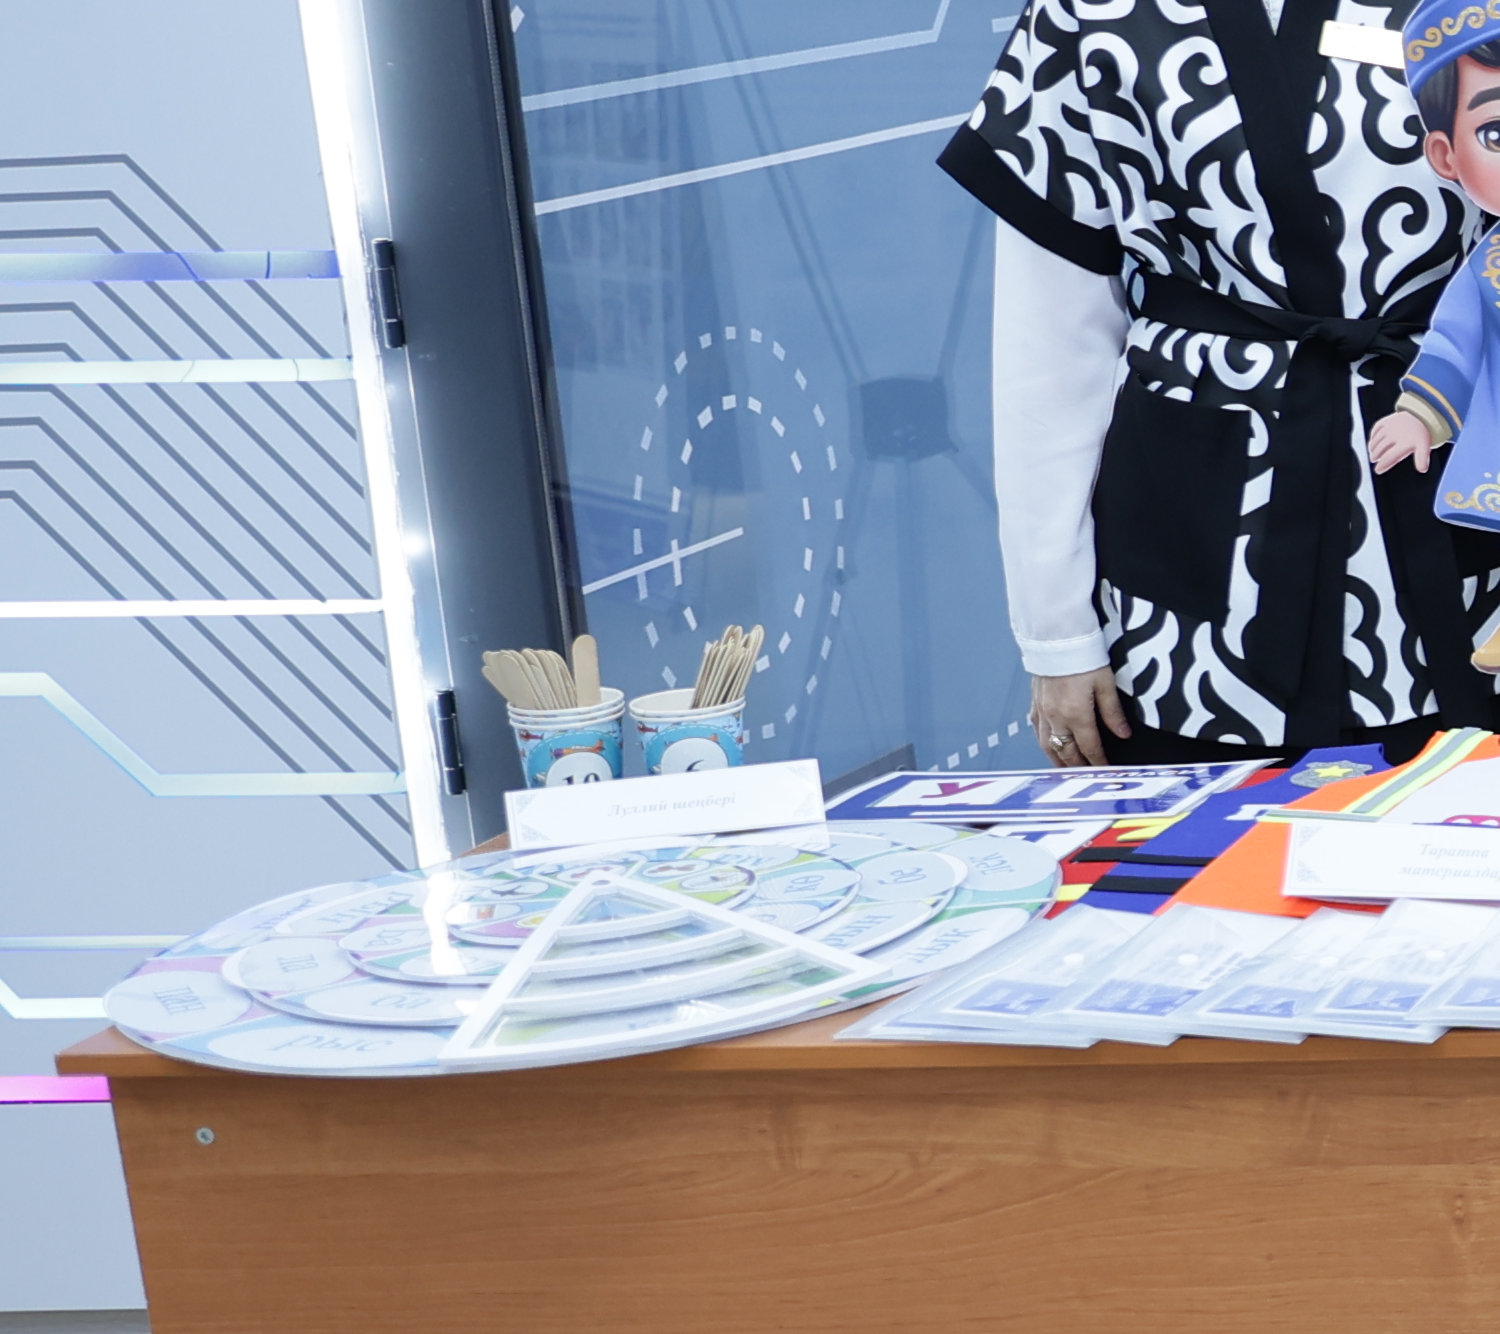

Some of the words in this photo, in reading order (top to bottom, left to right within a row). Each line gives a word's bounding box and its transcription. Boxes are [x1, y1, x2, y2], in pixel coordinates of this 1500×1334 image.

[1061, 767, 1208, 780] ТАСПАСЫ
[921, 780, 998, 799] У
[607, 799, 668, 818] Луллий
[672, 792, 737, 812] шеңбері
[1419, 843, 1491, 860] Таратпа
[277, 954, 319, 971] ла
[153, 986, 206, 1015] пан
